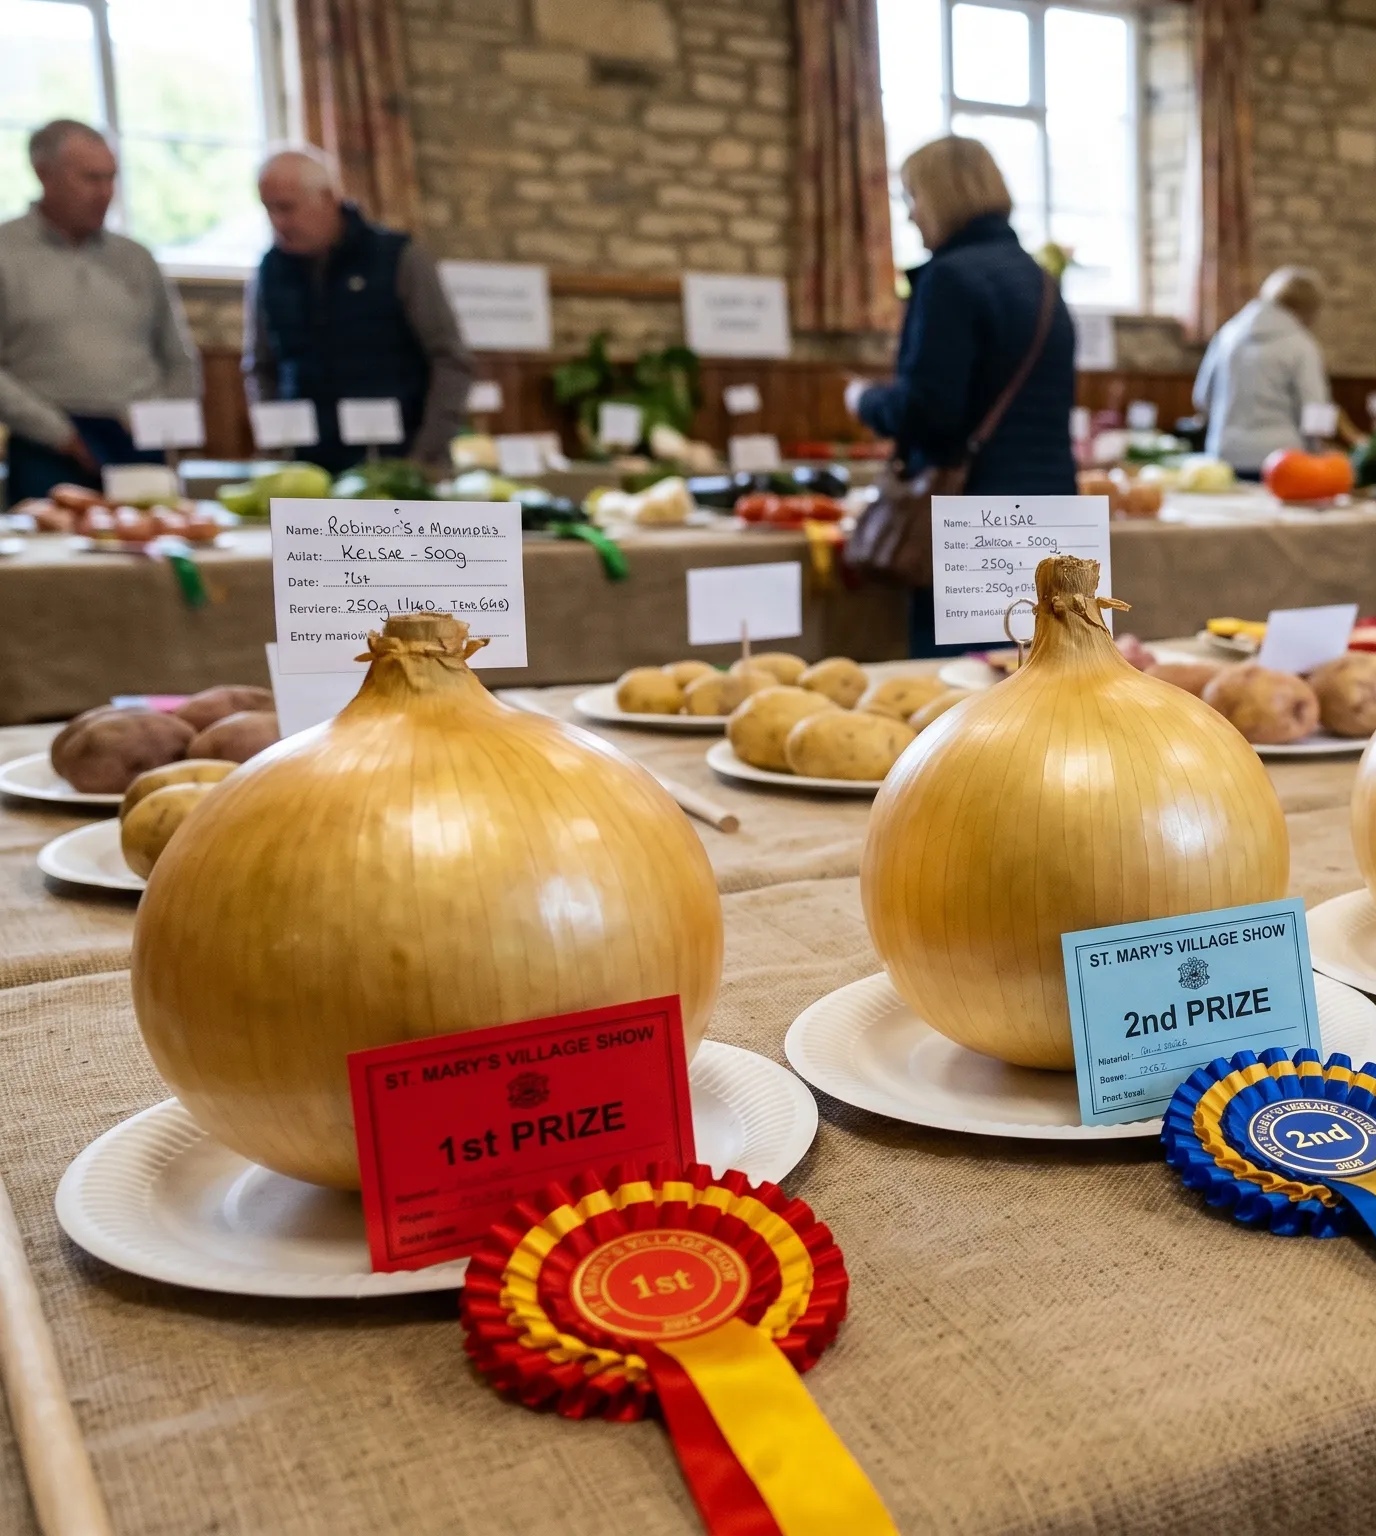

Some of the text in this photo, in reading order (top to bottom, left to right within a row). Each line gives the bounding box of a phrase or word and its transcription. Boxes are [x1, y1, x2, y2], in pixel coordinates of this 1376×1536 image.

[286, 525, 323, 536] Name:
[943, 519, 971, 528] Name:
[1027, 536, 1061, 555] 500g
[424, 546, 467, 569] 500g
[981, 559, 1014, 575] 250g
[944, 563, 968, 572] Date:
[288, 577, 319, 587] Date:
[986, 583, 1014, 598] 250g
[347, 599, 390, 622] 250g
[946, 609, 968, 619] Entry
[290, 632, 322, 643] Entry
[1089, 924, 1286, 967] ST. MARY'S VILLAGE SHOW
[1123, 987, 1271, 1038] 2nd PRIZE
[422, 1053, 501, 1083] MARY'S
[506, 1037, 590, 1066] VILLAGE
[595, 1025, 655, 1051] SHOW
[438, 1101, 626, 1166] 1st PRIZE
[1286, 1123, 1352, 1149] 2nd
[630, 1268, 695, 1300] 1st
